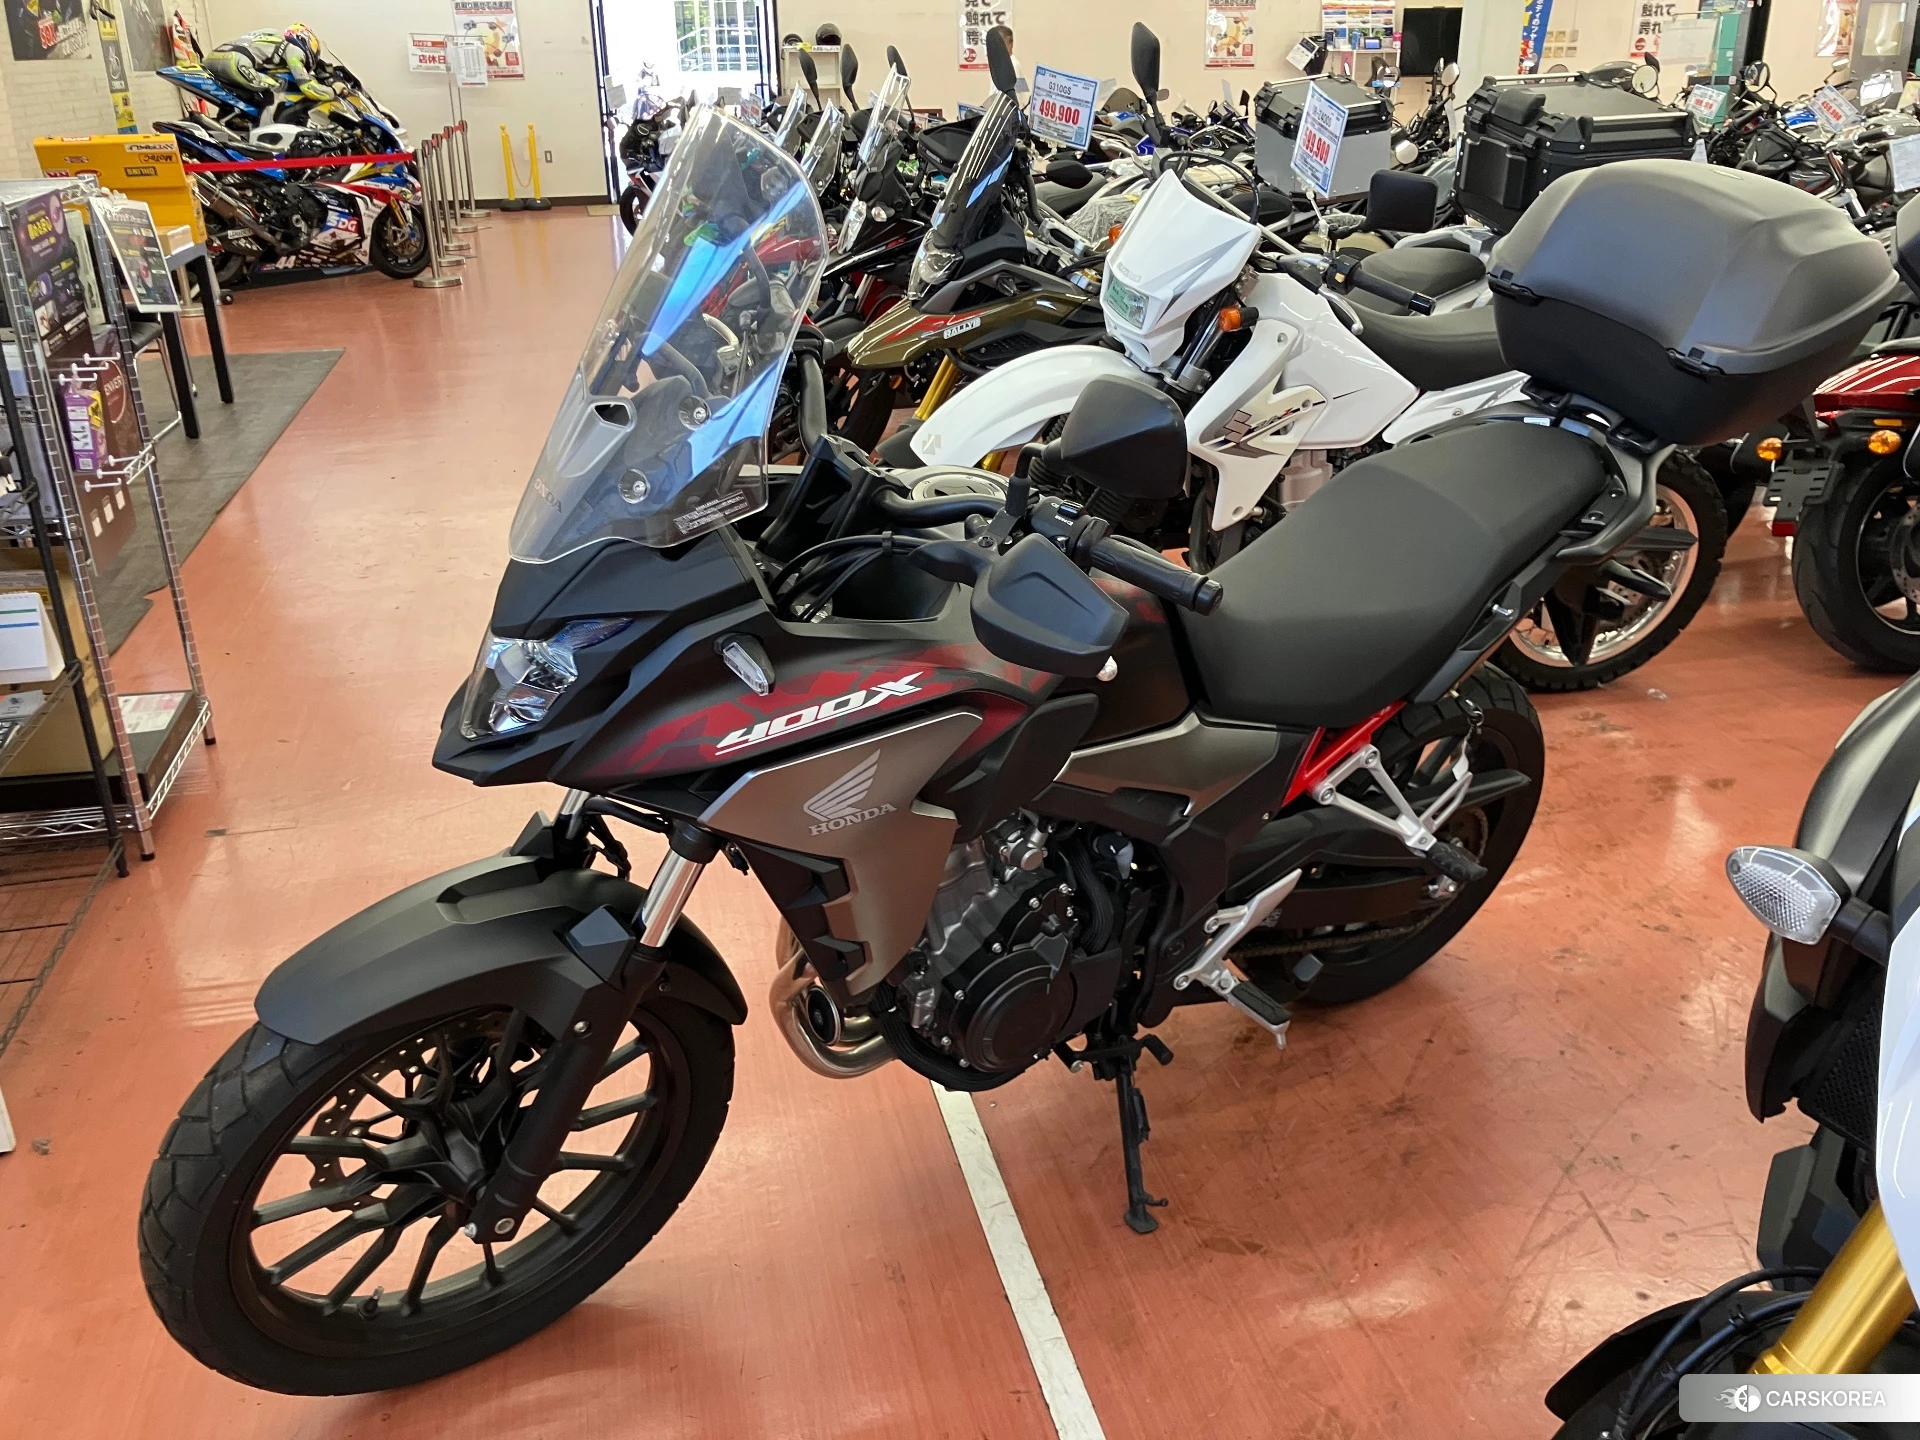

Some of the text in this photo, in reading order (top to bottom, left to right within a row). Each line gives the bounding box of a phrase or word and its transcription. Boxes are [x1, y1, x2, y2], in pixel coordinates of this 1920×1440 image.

[965, 11, 1006, 25] 触れて
[418, 54, 446, 65] 店休日
[1048, 81, 1072, 95] G310GS
[1039, 98, 1080, 126] 499,900
[326, 214, 358, 231] SDG
[275, 254, 297, 269] 44
[531, 474, 562, 514] ONDA
[715, 671, 924, 755] 400X
[808, 803, 898, 836] HONDA
